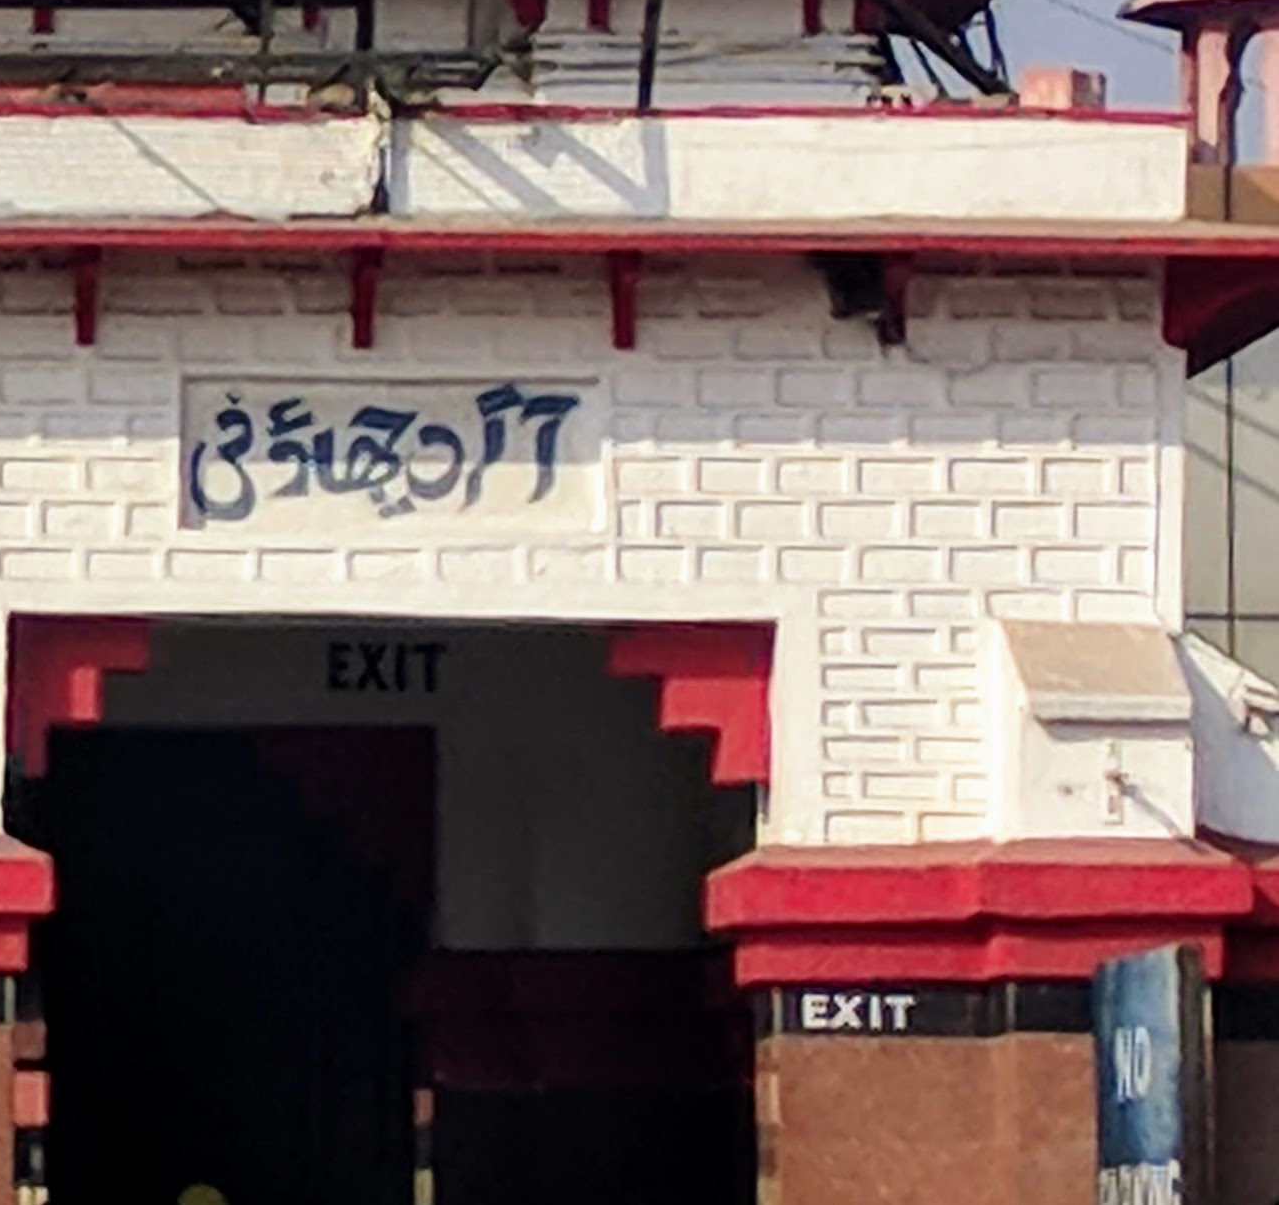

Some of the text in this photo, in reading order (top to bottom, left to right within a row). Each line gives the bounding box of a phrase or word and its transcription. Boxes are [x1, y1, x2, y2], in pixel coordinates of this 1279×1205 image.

[327, 641, 448, 694] EXIT
[801, 993, 917, 1032] EXIT
[1114, 1026, 1153, 1103] NO
